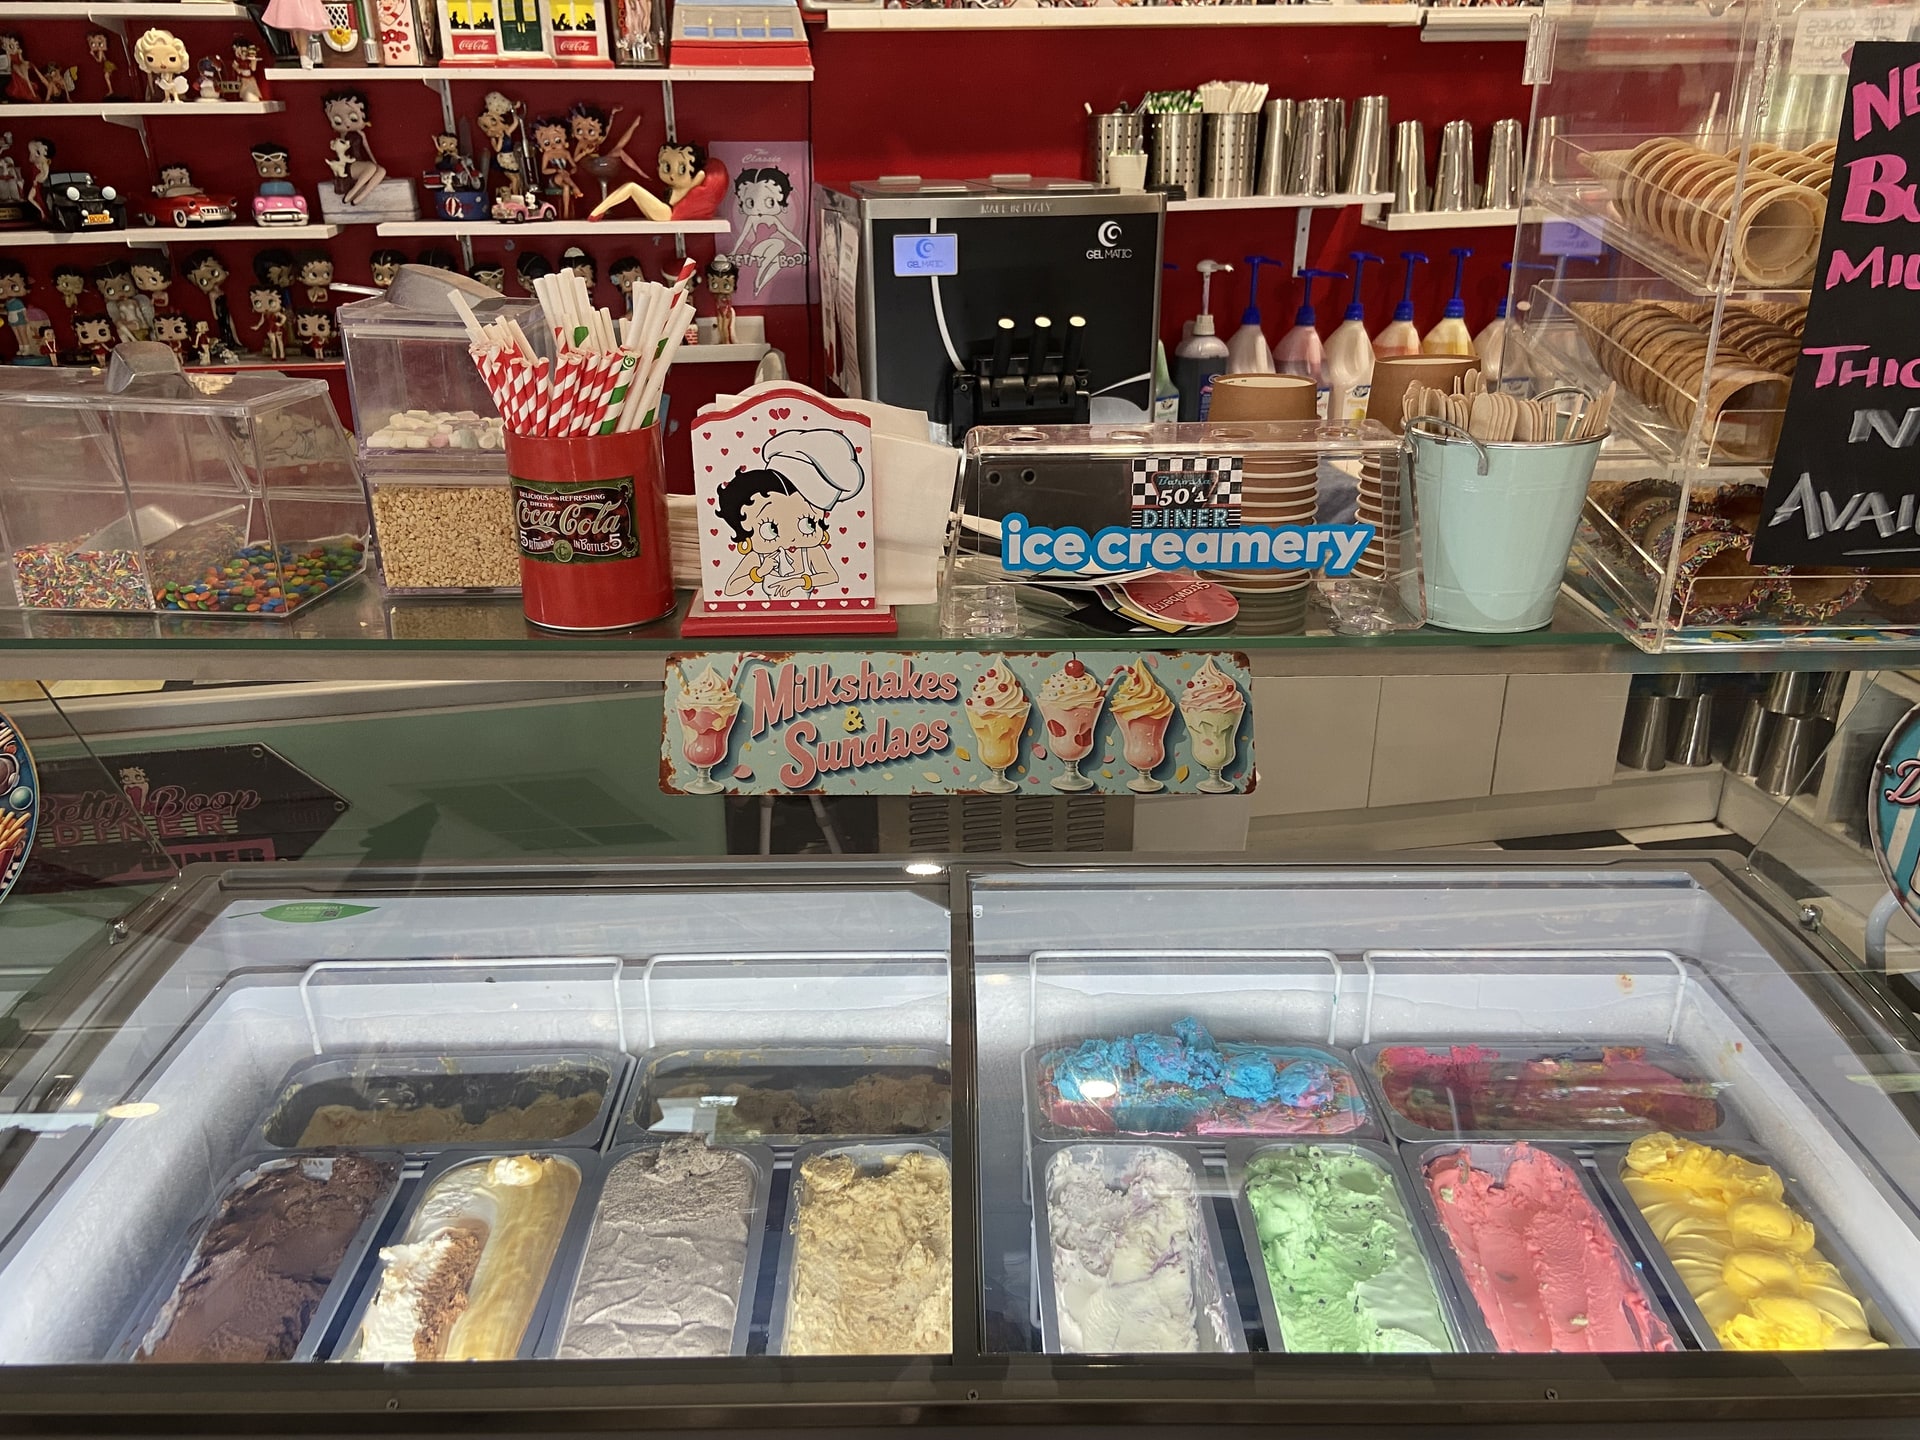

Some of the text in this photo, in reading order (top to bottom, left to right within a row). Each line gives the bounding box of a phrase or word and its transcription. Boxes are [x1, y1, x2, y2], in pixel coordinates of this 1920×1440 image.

[741, 154, 782, 164] Classic
[519, 490, 549, 500] DELICIOUS
[560, 492, 606, 502] REFRESHING
[1158, 486, 1209, 507] 50's
[515, 498, 622, 536] Coca-Cola
[1141, 507, 1230, 530] DINER
[580, 537, 610, 553] BOTTLES
[1008, 518, 1369, 571] ice creamery
[1147, 581, 1211, 614] Strawberry
[751, 658, 960, 737] Milkshakes
[842, 705, 865, 732] &
[779, 716, 950, 790] Sundaes
[150, 784, 262, 819] Boop
[53, 812, 229, 847] DINER
